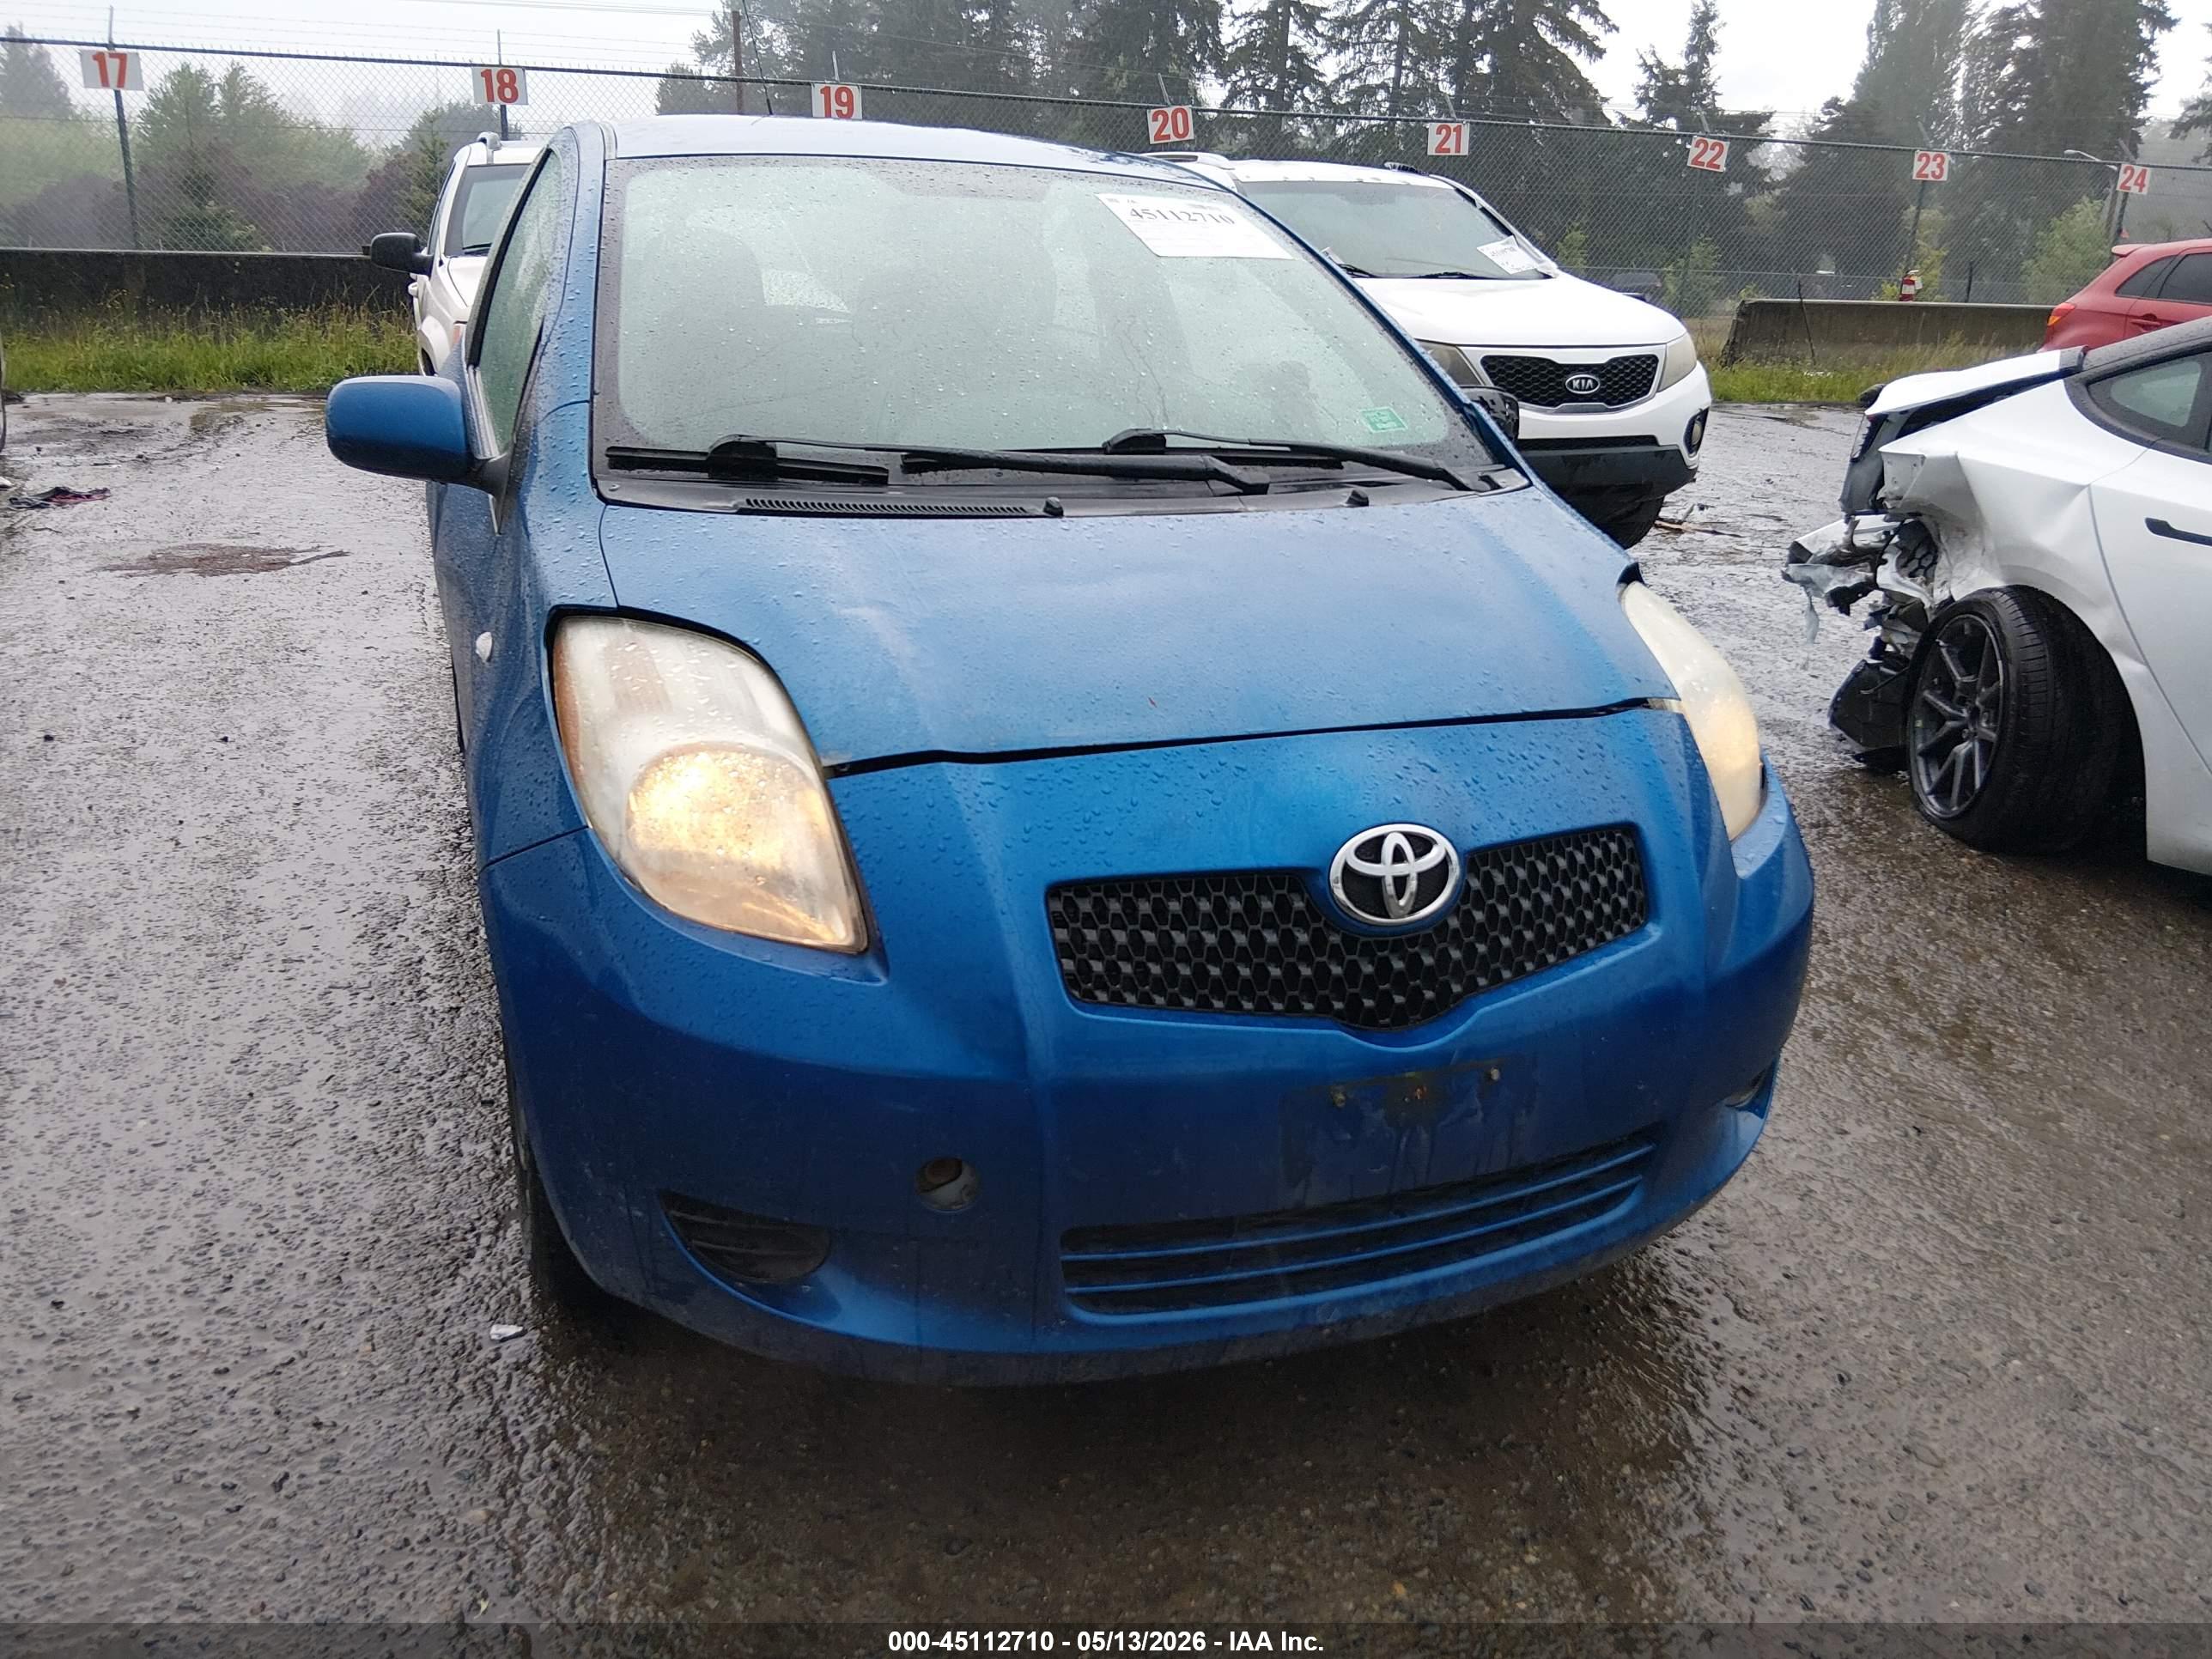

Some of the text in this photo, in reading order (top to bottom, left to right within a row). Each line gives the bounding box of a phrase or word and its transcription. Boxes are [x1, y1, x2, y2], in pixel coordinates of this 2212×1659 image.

[93, 52, 129, 88] 17
[481, 69, 518, 102] 18
[820, 86, 854, 118] 19
[1152, 107, 1191, 141] 20
[1435, 125, 1462, 155] 21
[1691, 138, 1725, 169] 22
[1917, 153, 1946, 179] 23
[2121, 165, 2148, 191] 24
[1130, 208, 1235, 225] 45112710
[1572, 379, 1593, 390] KIA
